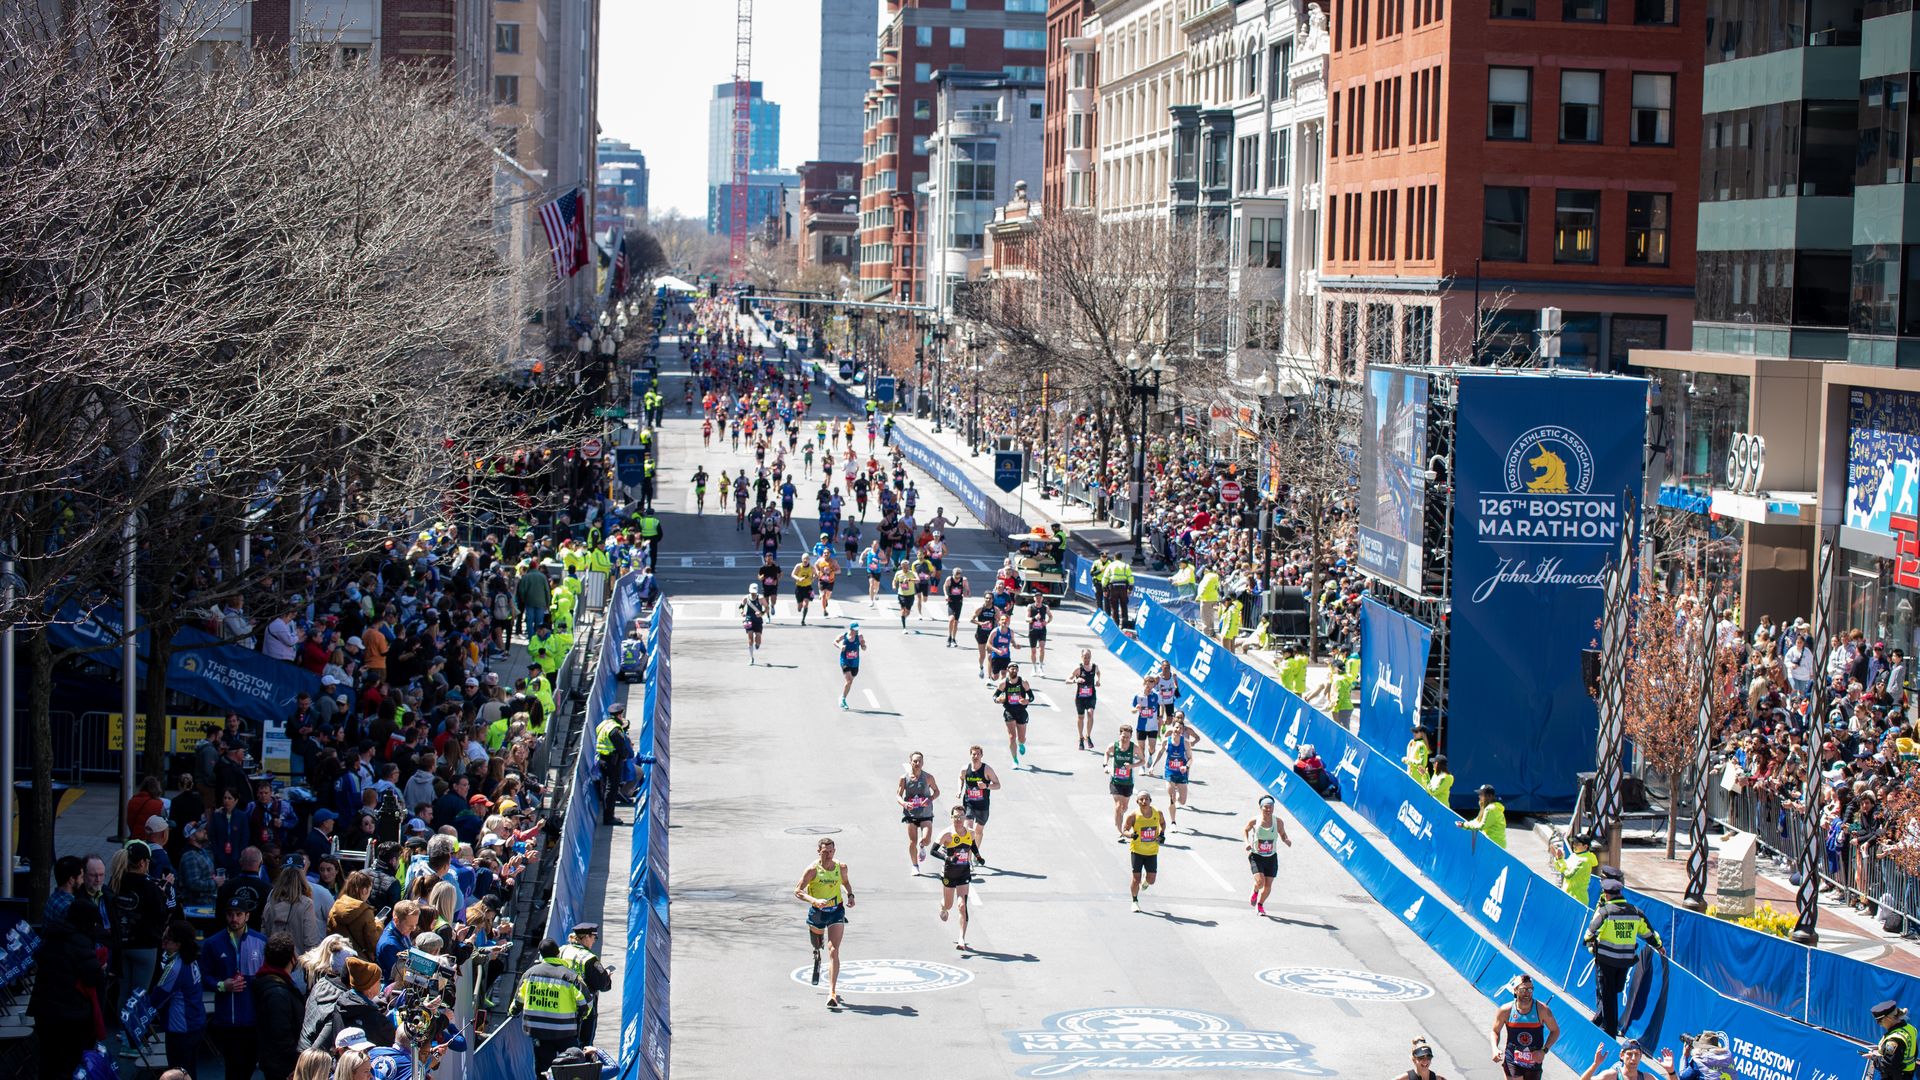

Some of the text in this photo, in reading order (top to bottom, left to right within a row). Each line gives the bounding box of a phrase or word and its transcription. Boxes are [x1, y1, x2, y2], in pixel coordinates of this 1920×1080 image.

[1509, 429, 1593, 491] BOSTON ATHLETIC ASSOCIATION
[1726, 432, 1765, 495] 699
[1479, 499, 1616, 518] 126TH BOSTON
[1478, 519, 1616, 538] MARATHON
[1472, 556, 1606, 603] John Hancock
[1146, 588, 1170, 598] BOSTON
[202, 669, 271, 700] MARATHON
[207, 660, 273, 691] THE BOSTON
[1614, 920, 1634, 930] BOSTON
[1616, 930, 1632, 939] POLICE
[530, 982, 559, 997] Boston
[529, 996, 559, 1009] Police
[1023, 1042, 1294, 1051] MARATHON
[1117, 1034, 1287, 1043] BOSTON
[1031, 1055, 1322, 1075] John Hancock
[1732, 1038, 1795, 1073] THE BOSTON
